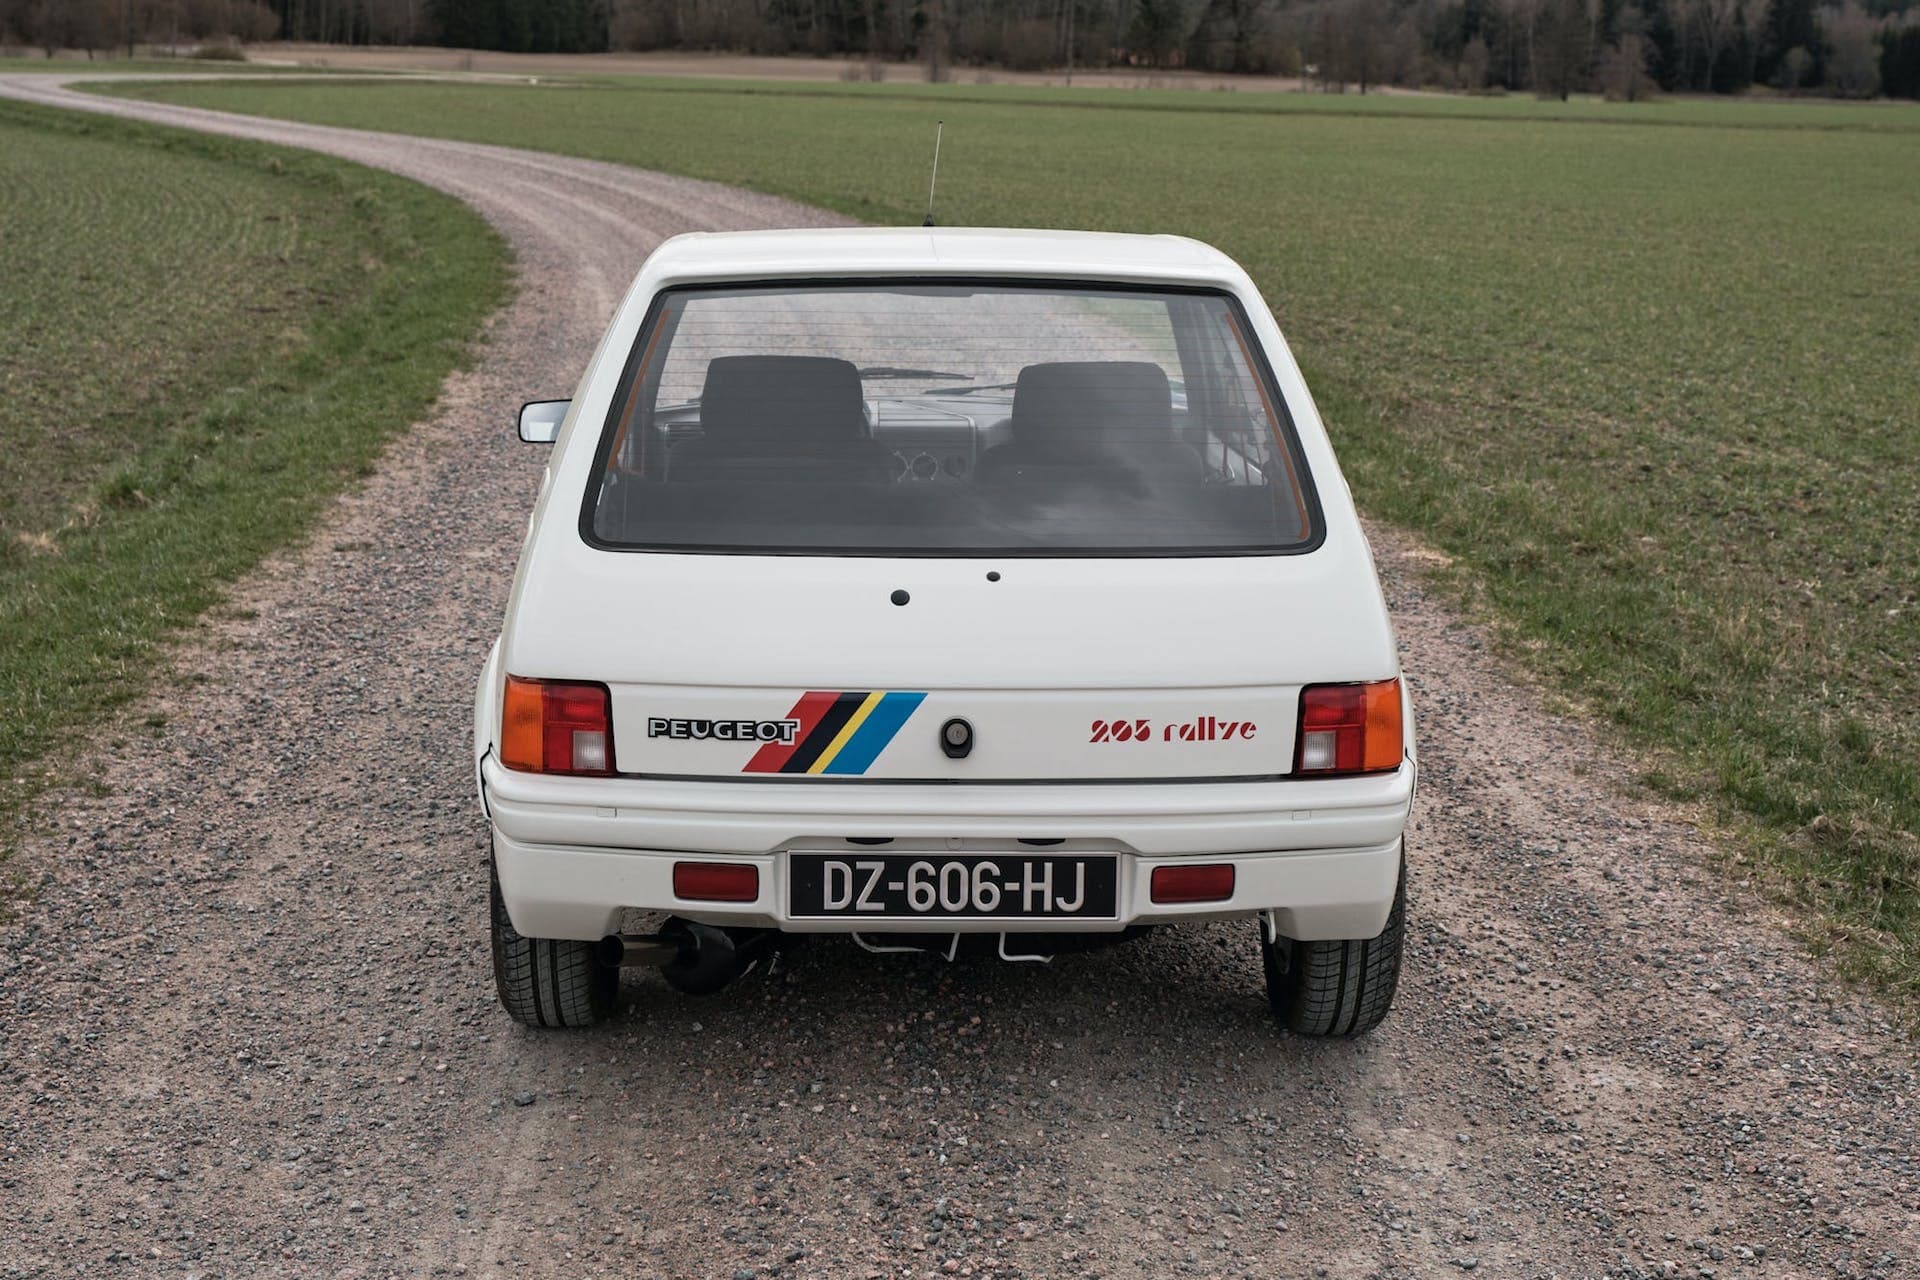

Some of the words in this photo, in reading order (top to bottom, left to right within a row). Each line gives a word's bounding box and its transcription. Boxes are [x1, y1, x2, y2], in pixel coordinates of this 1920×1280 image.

[648, 717, 798, 742] PEUGEOT
[1089, 719, 1151, 743] 205
[1164, 716, 1257, 742] rallye
[823, 860, 1085, 912] DZ-606-HJ
